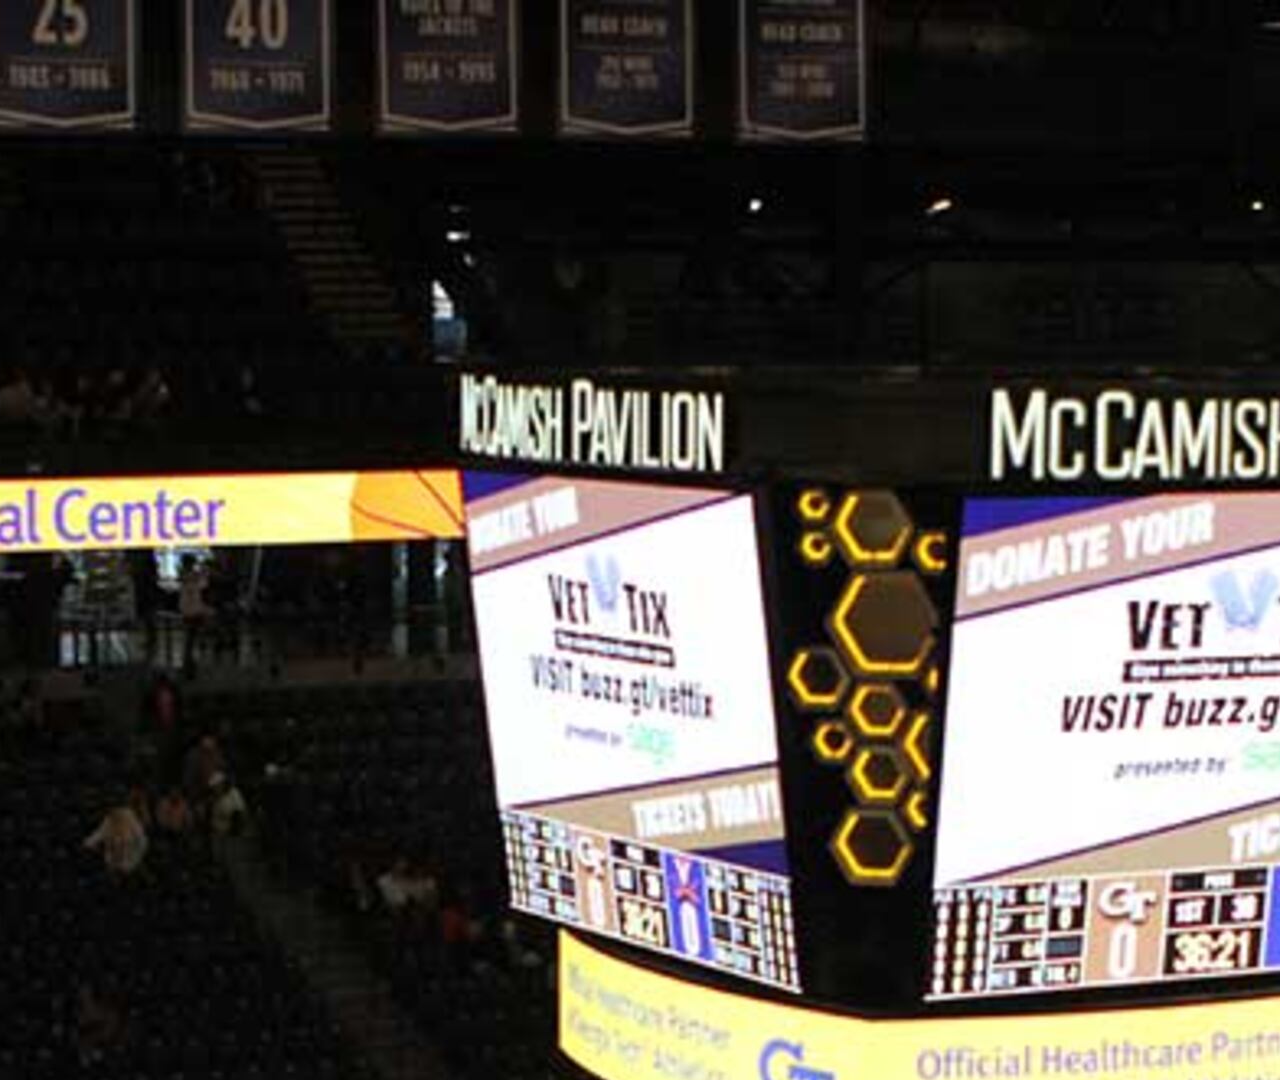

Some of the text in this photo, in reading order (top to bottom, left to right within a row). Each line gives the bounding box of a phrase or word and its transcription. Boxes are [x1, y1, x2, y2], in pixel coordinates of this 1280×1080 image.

[31, 0, 89, 46] 25
[224, 0, 289, 49] 40
[52, 488, 226, 546] Center
[966, 503, 1215, 597] DONATE YOUR
[1127, 599, 1212, 651] VET
[1061, 693, 1152, 733] VISIT
[1110, 926, 1137, 979] 0
[1041, 1035, 1203, 1075] Healthcare
